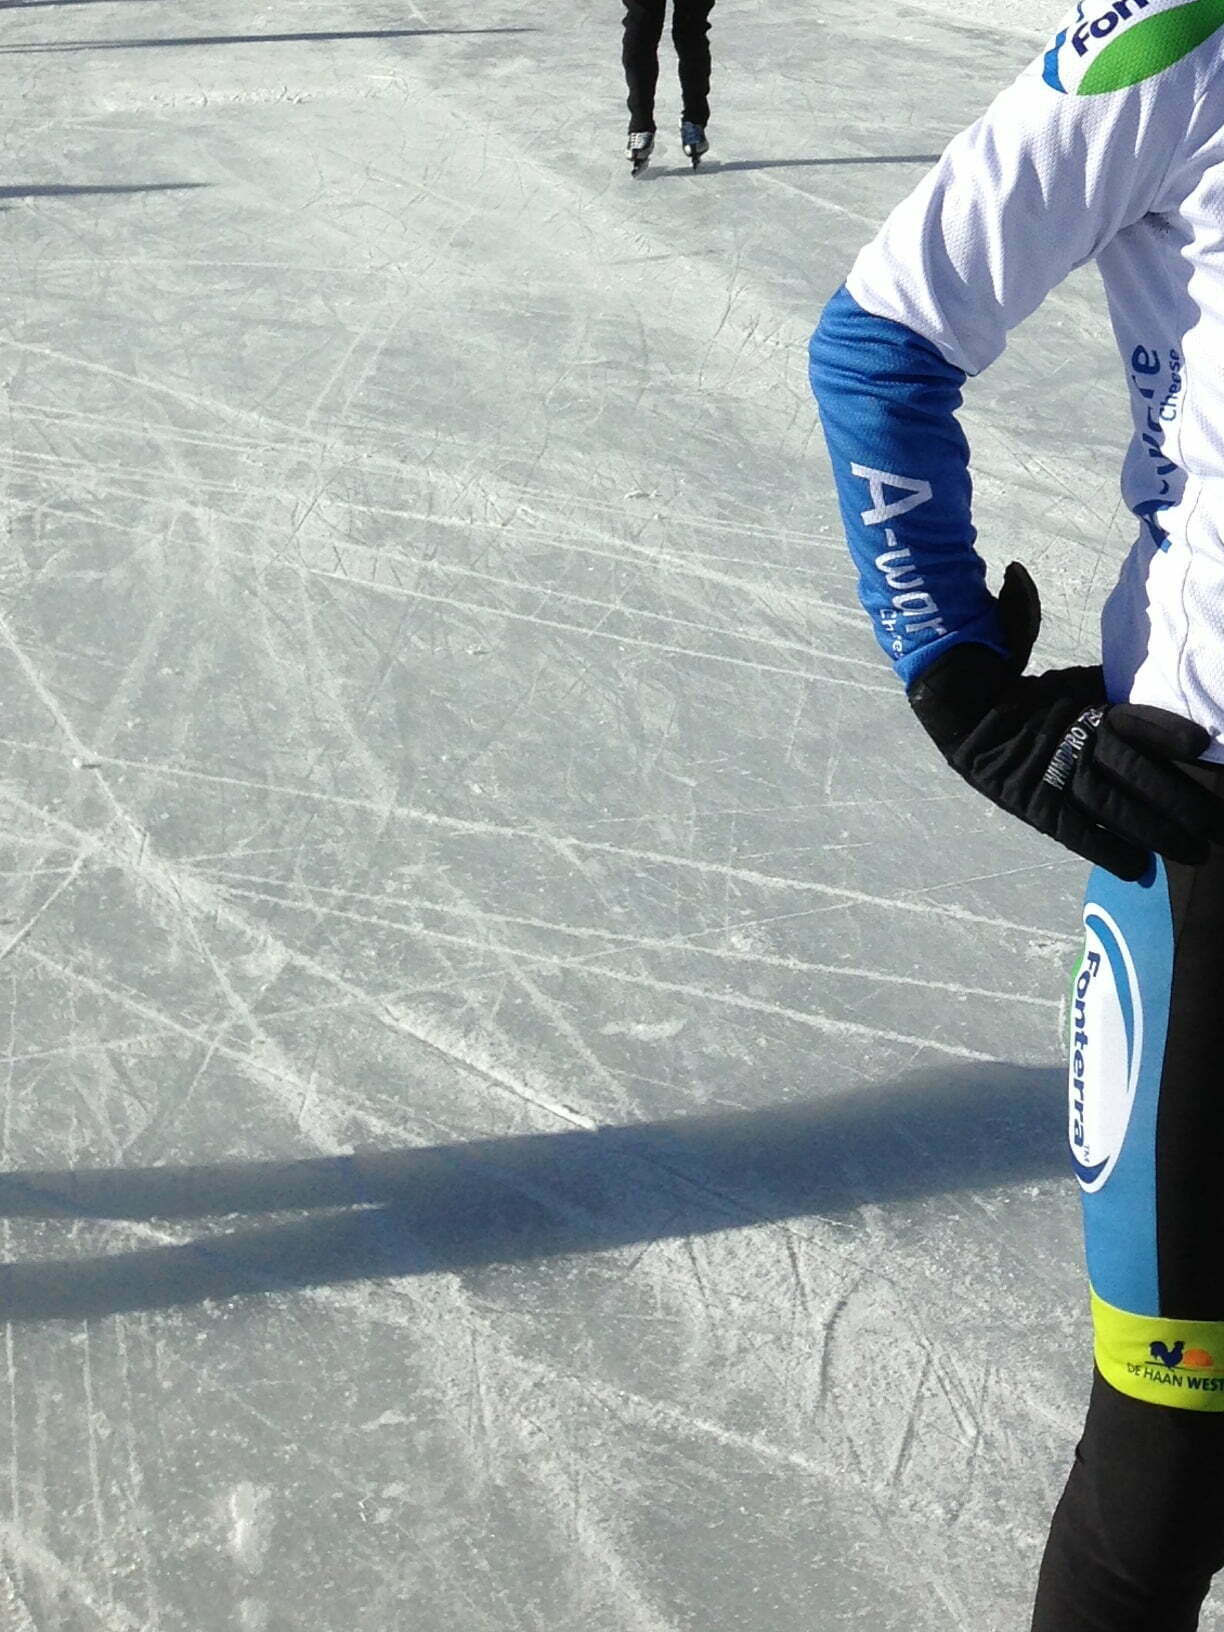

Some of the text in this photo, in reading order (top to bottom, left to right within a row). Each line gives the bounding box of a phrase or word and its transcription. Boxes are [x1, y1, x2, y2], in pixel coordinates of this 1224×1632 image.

[1159, 348, 1182, 422] Cheese
[1073, 951, 1100, 1147] Fonterra
[1127, 1362, 1141, 1376] DE
[1144, 1368, 1183, 1387] HAAN
